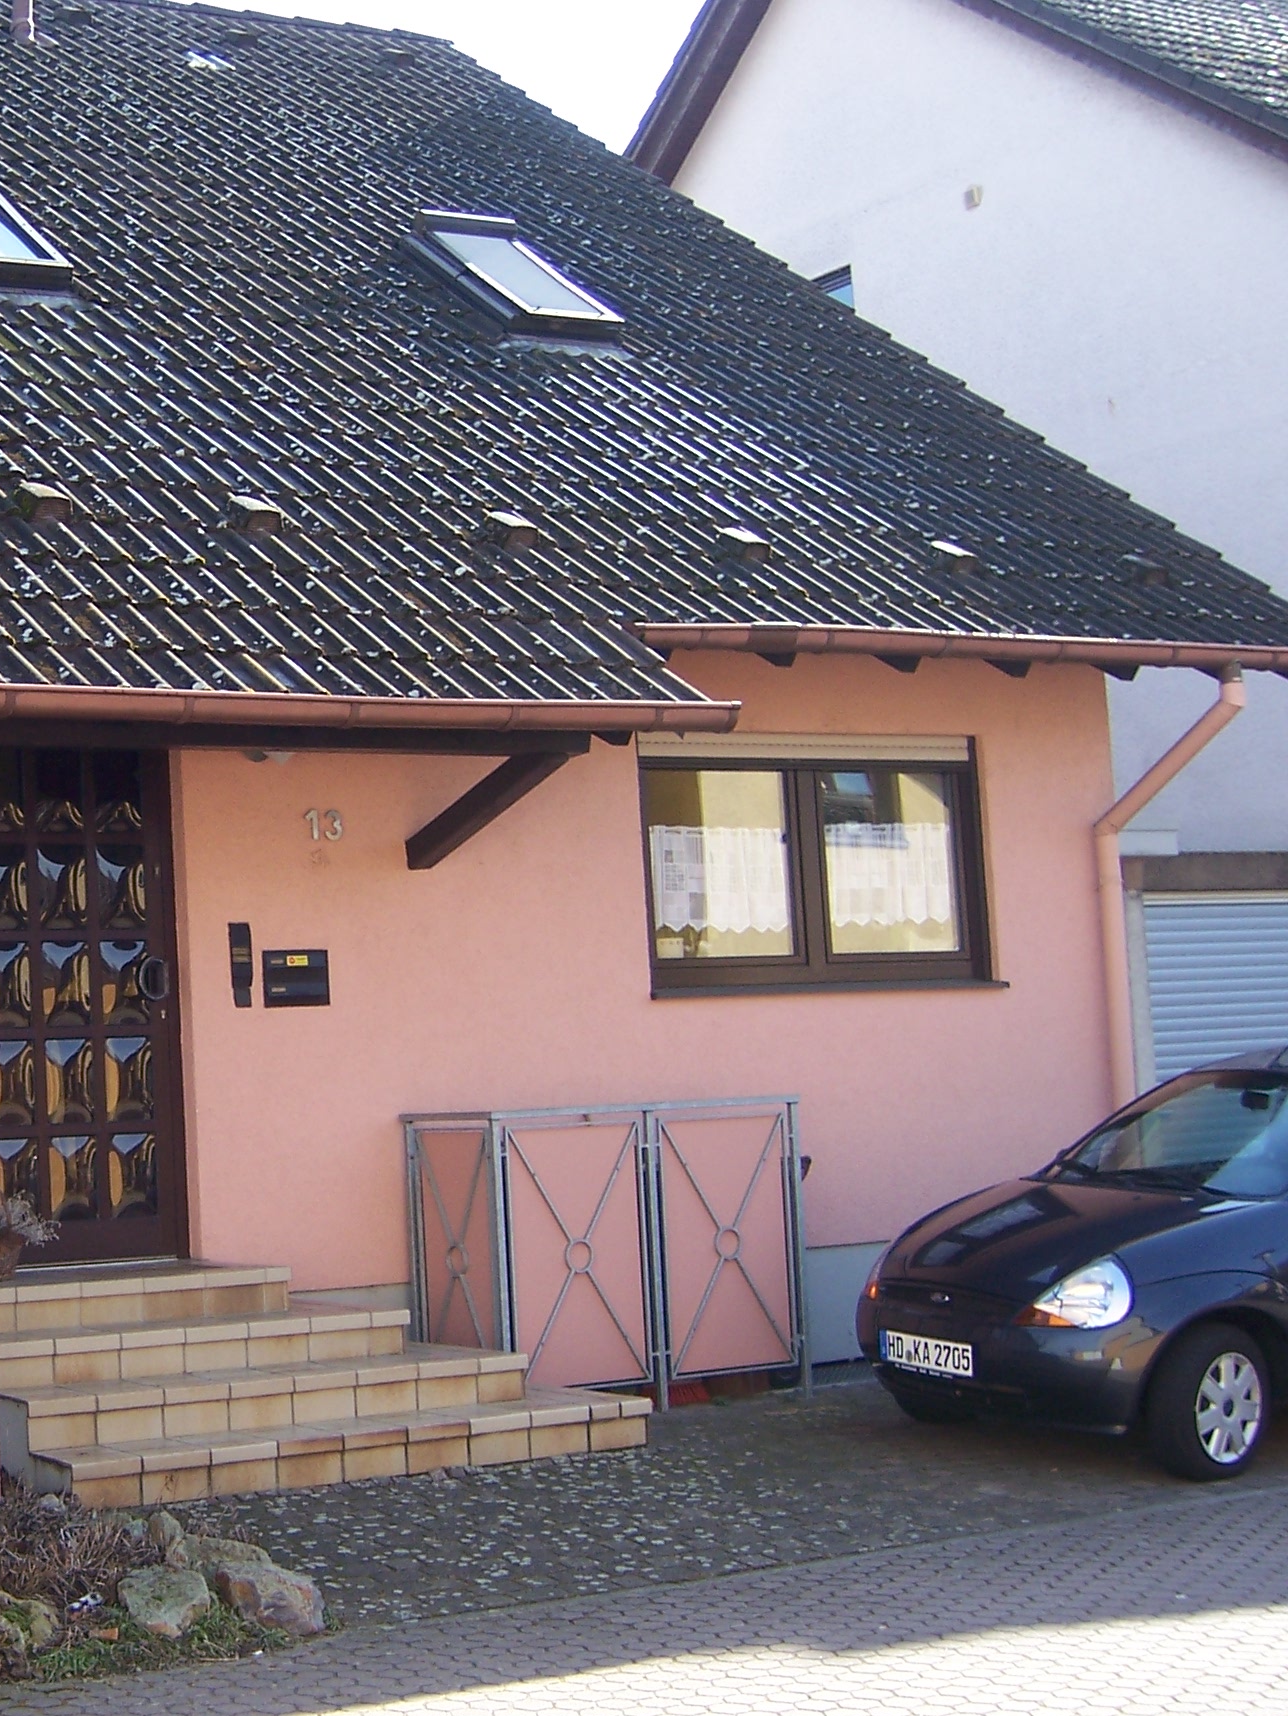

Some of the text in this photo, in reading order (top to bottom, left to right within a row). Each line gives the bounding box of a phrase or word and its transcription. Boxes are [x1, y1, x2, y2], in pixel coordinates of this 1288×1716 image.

[304, 809, 343, 841] 13
[887, 1334, 904, 1359] HD
[913, 1339, 930, 1364] KA
[934, 1344, 970, 1371] 2705
